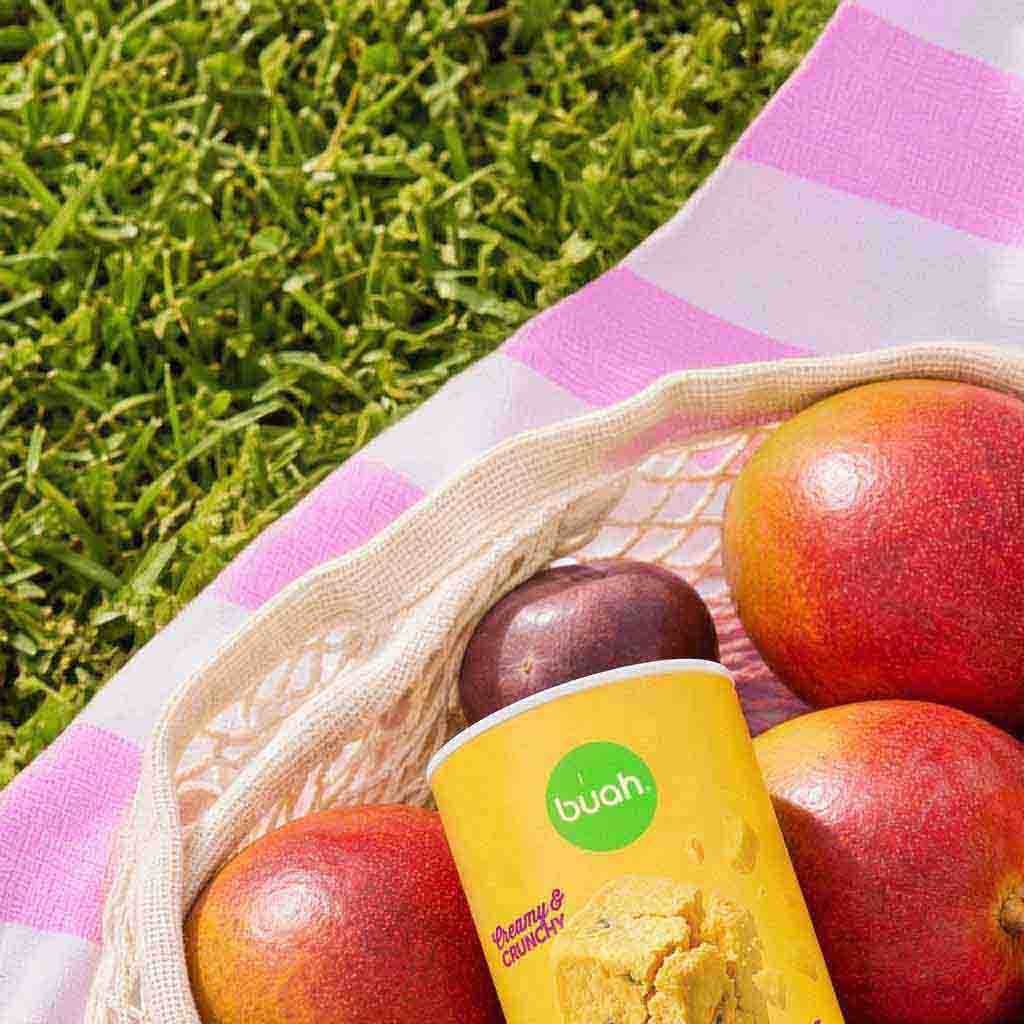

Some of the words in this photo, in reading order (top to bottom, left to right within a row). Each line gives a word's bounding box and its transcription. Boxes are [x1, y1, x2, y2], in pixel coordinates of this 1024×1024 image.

[491, 902, 547, 951] Creamy
[550, 888, 565, 911] &
[502, 912, 565, 968] CRUNCHY
